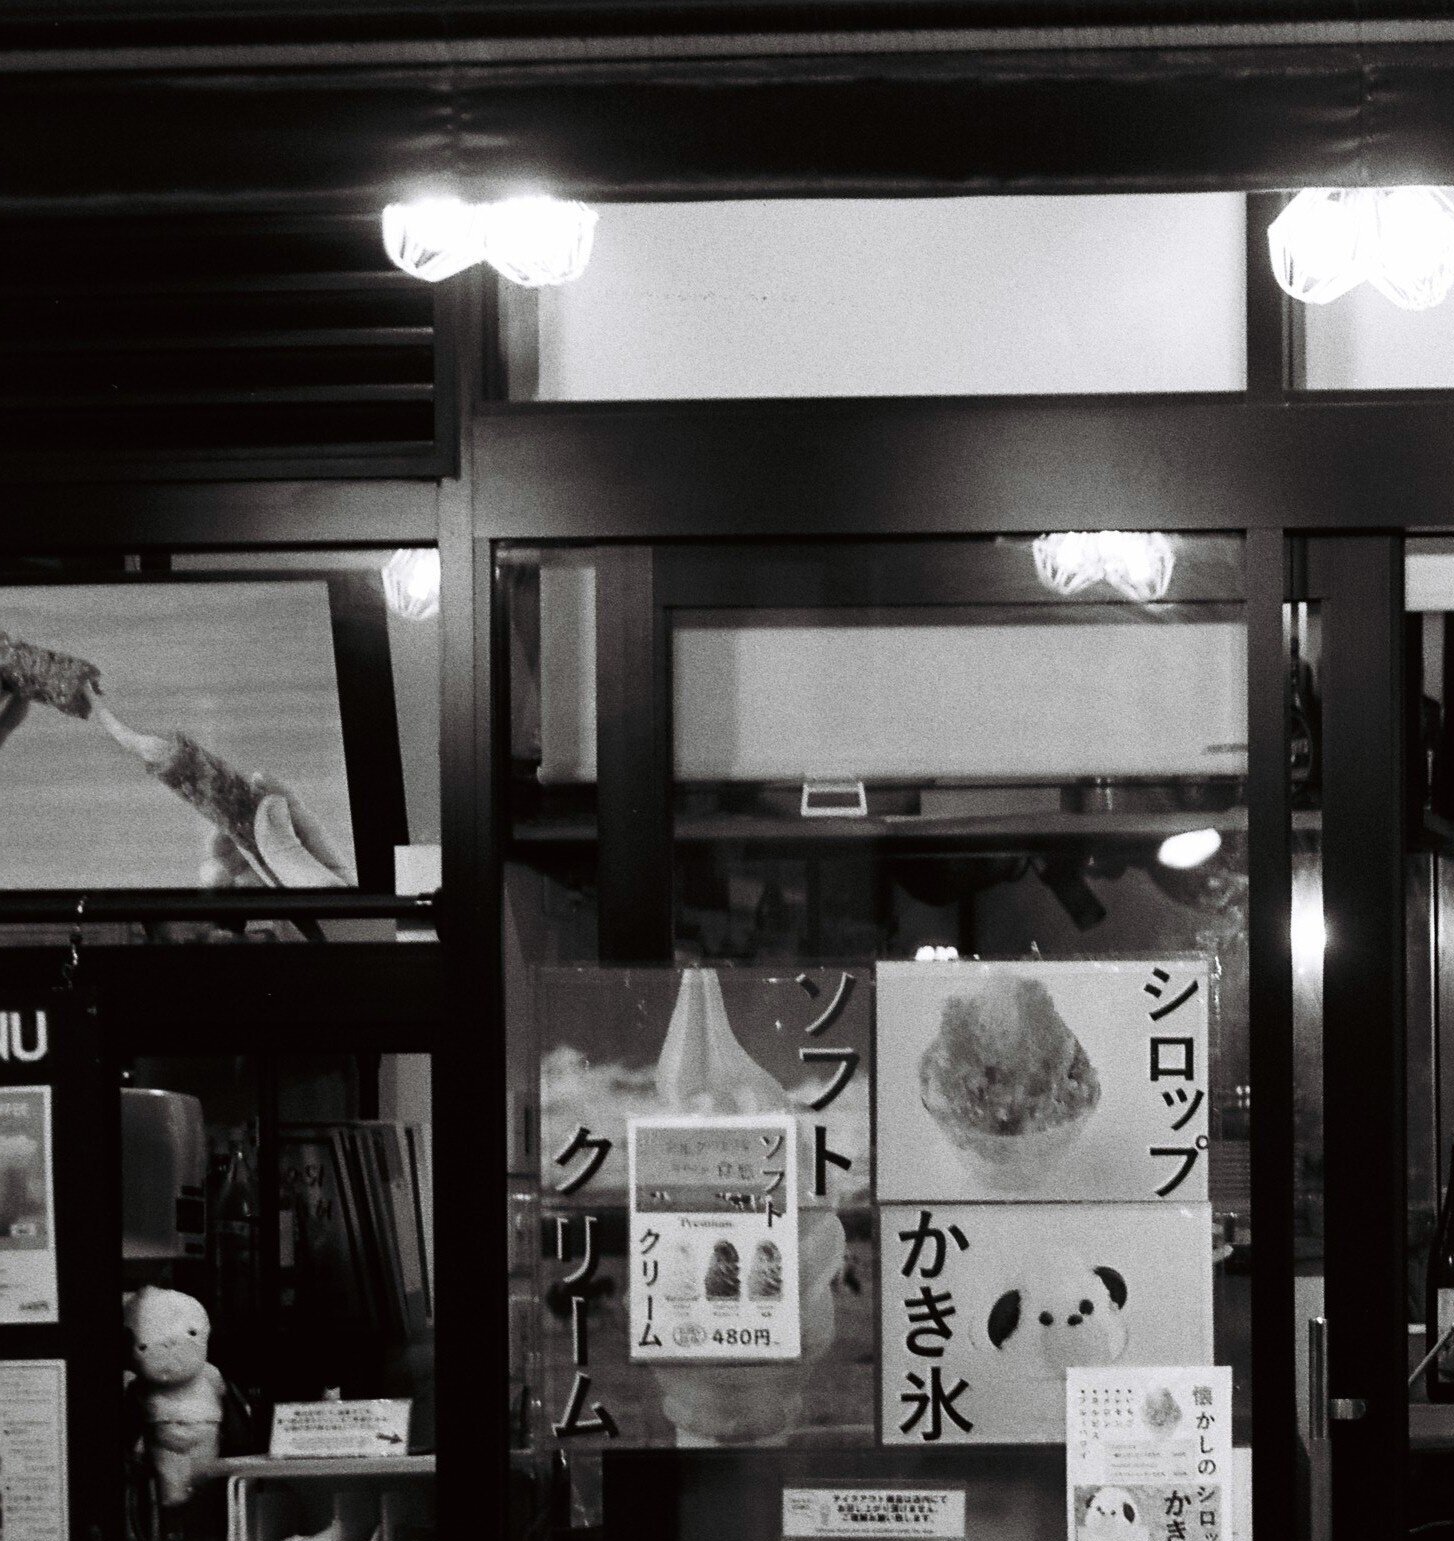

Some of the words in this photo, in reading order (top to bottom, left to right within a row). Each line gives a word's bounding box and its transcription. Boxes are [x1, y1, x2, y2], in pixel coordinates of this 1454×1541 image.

[760, 1134, 787, 1228] ソフト
[797, 972, 862, 1197] ソフト
[1141, 966, 1211, 1199] シロップ
[551, 1126, 620, 1441] クリーム
[637, 1228, 663, 1347] クリーム
[712, 1329, 771, 1347] 480円
[898, 1208, 974, 1443] かき氷
